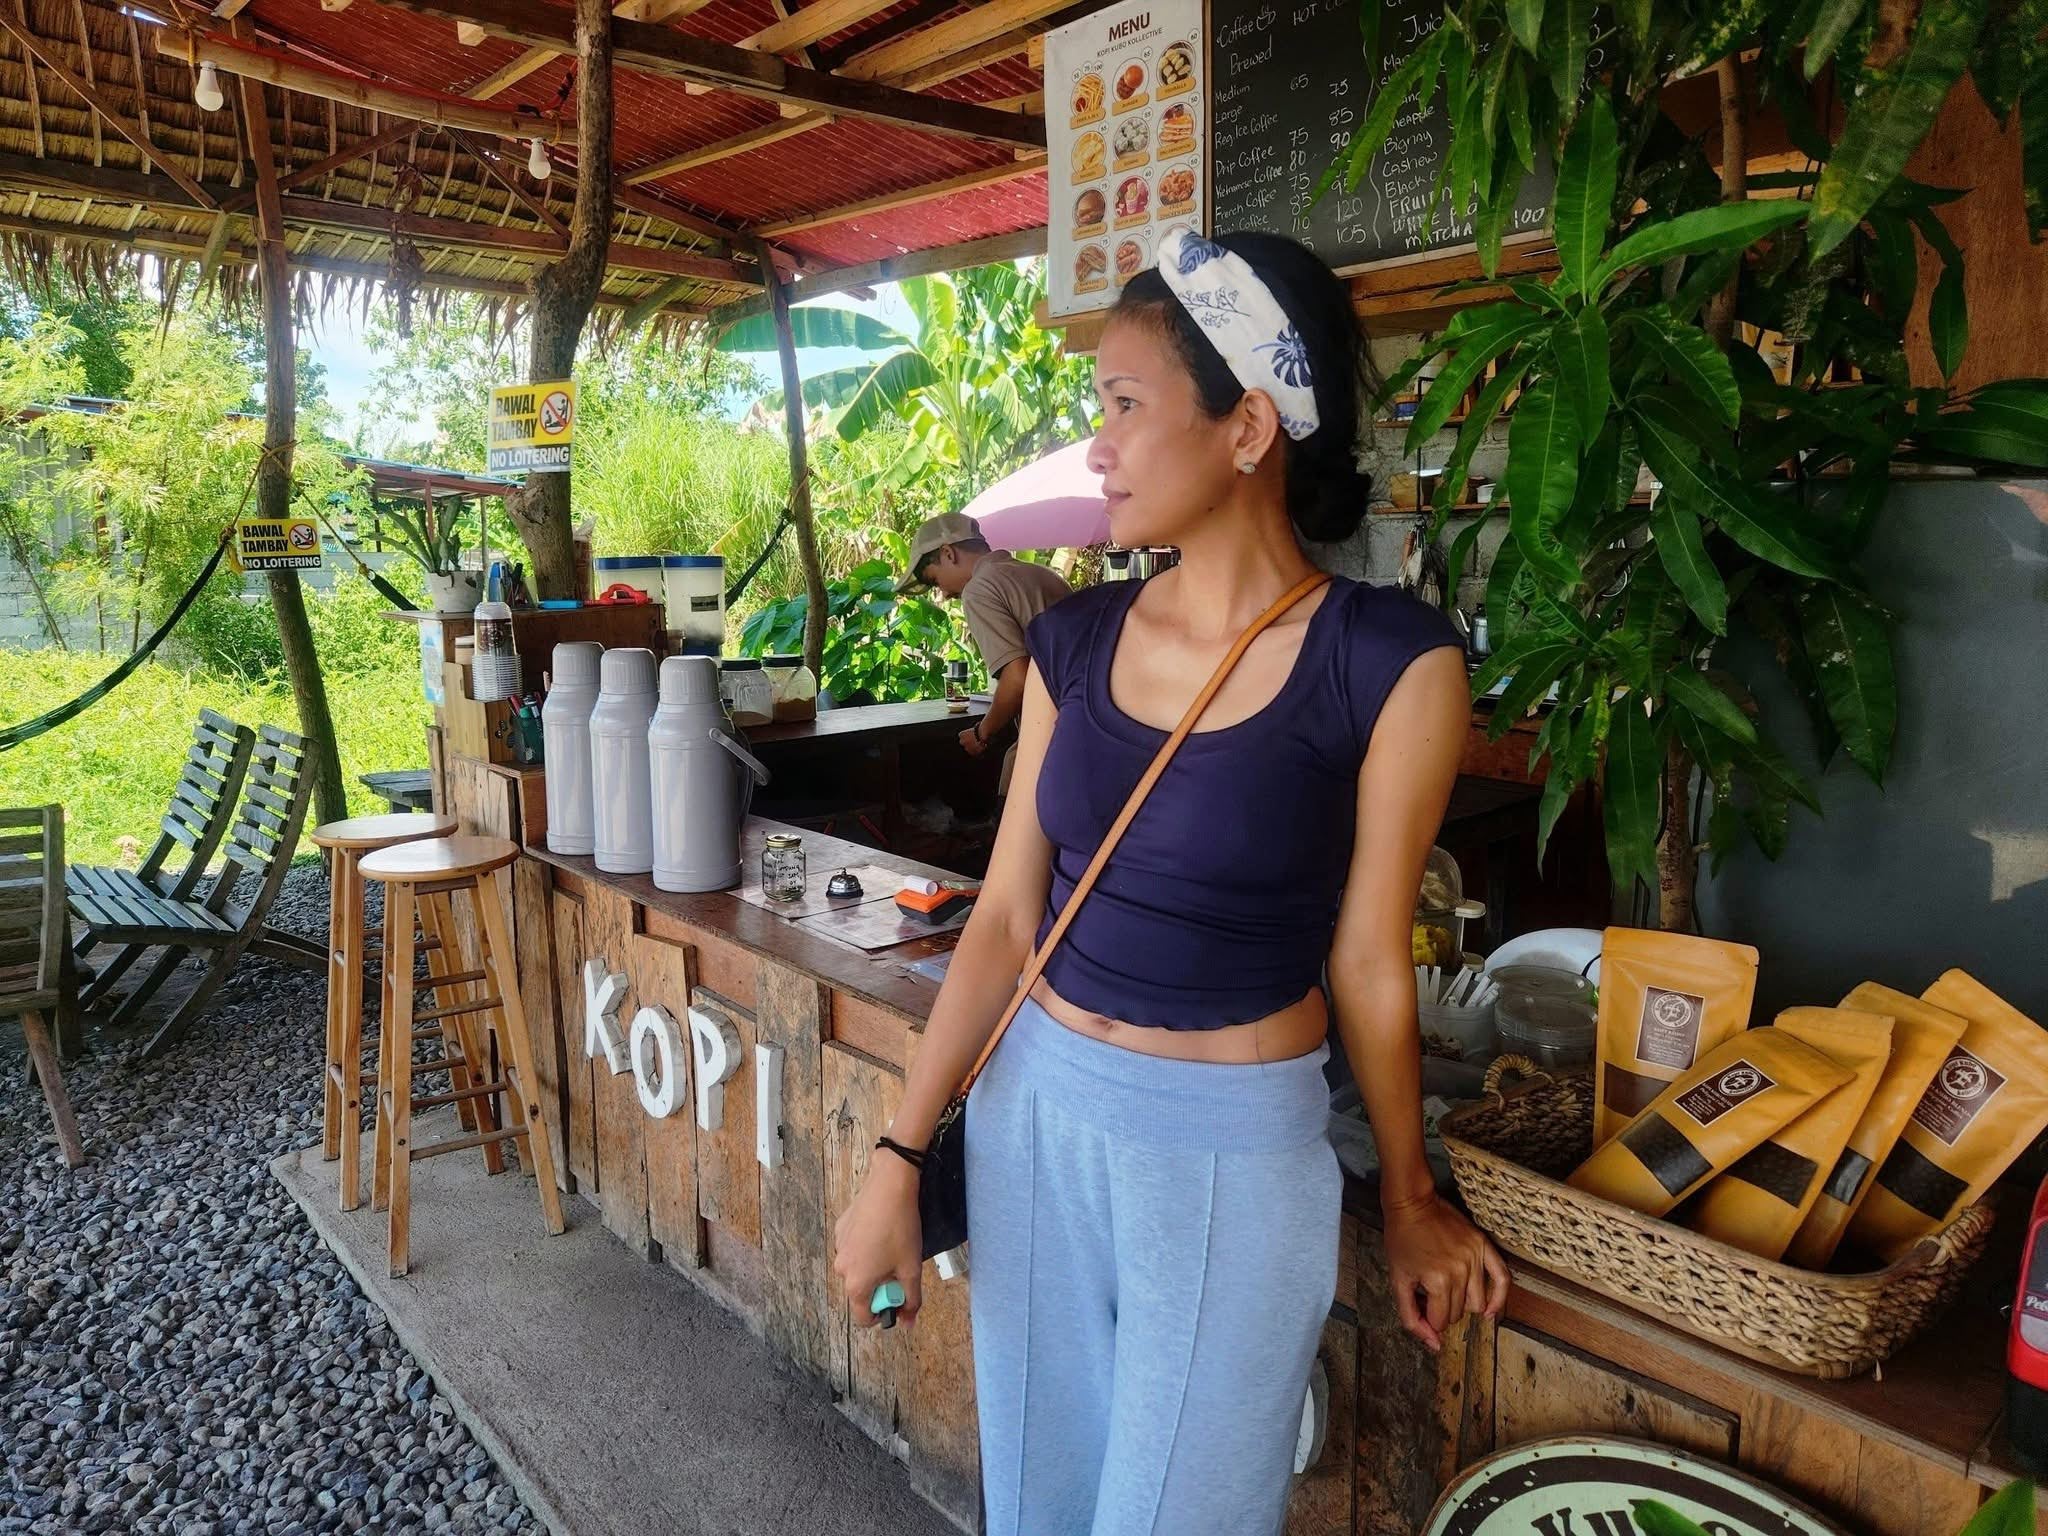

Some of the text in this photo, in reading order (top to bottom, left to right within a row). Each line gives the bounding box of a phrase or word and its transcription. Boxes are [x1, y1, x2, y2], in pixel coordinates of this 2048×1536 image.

[1108, 12, 1150, 42] MENU
[1293, 3, 1318, 25] HOT
[1127, 28, 1163, 47] KOLLECTIVE
[1217, 16, 1253, 47] Coffee
[1403, 14, 1443, 42] Juic
[1230, 33, 1272, 75] Brewed
[1215, 84, 1250, 104] Medium
[1329, 78, 1348, 97] 75
[1216, 105, 1353, 126] Large 85
[1251, 112, 1278, 135] Coffee
[1289, 127, 1308, 147] 75
[1330, 132, 1350, 149] 90
[1215, 160, 1236, 178] Drip
[1238, 146, 1277, 168] Coffee
[1290, 150, 1306, 172] 80
[1382, 152, 1438, 178] Cashew
[1254, 165, 1283, 184] Coffee
[1289, 173, 1310, 191] 75
[1215, 189, 1363, 222] French Coffee 85 120
[1514, 207, 1545, 229] 100
[1238, 213, 1269, 231] Coffee
[1336, 224, 1366, 244] 105
[496, 394, 536, 416] BAWAL
[492, 418, 538, 442] TAMBAY
[491, 446, 569, 468] NO LOITERING
[242, 525, 285, 538] BAWAL
[241, 540, 288, 553] TAMBAY
[244, 557, 320, 569] NO LOITERING
[585, 958, 784, 1169] KOPI
